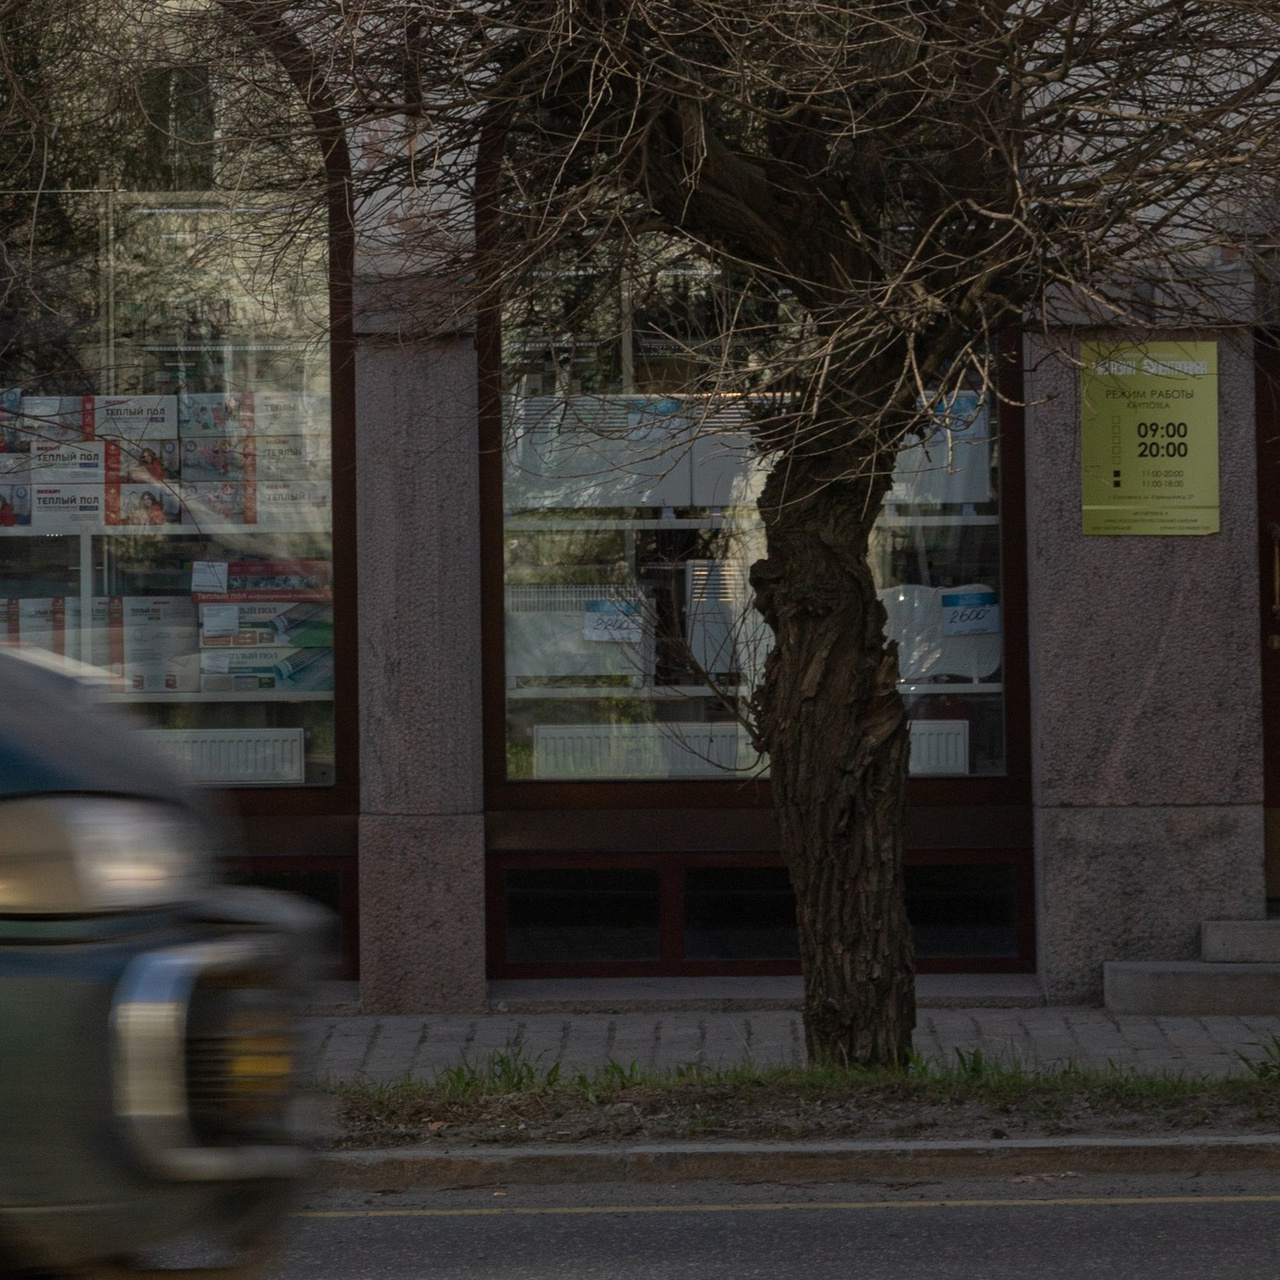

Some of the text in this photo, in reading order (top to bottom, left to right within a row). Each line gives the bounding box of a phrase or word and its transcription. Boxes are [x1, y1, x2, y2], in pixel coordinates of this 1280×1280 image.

[1105, 389, 1194, 400] РЕЖИМ РАБОТЫ
[105, 407, 165, 416] ТЕПЛЫЙ ПОЛ
[1137, 422, 1188, 438] 09:00
[1137, 442, 1188, 458] 20:00
[37, 452, 99, 461] ТЕПЛЫЙ ПОЛ
[36, 495, 77, 504] ТЕПЛЫЙ
